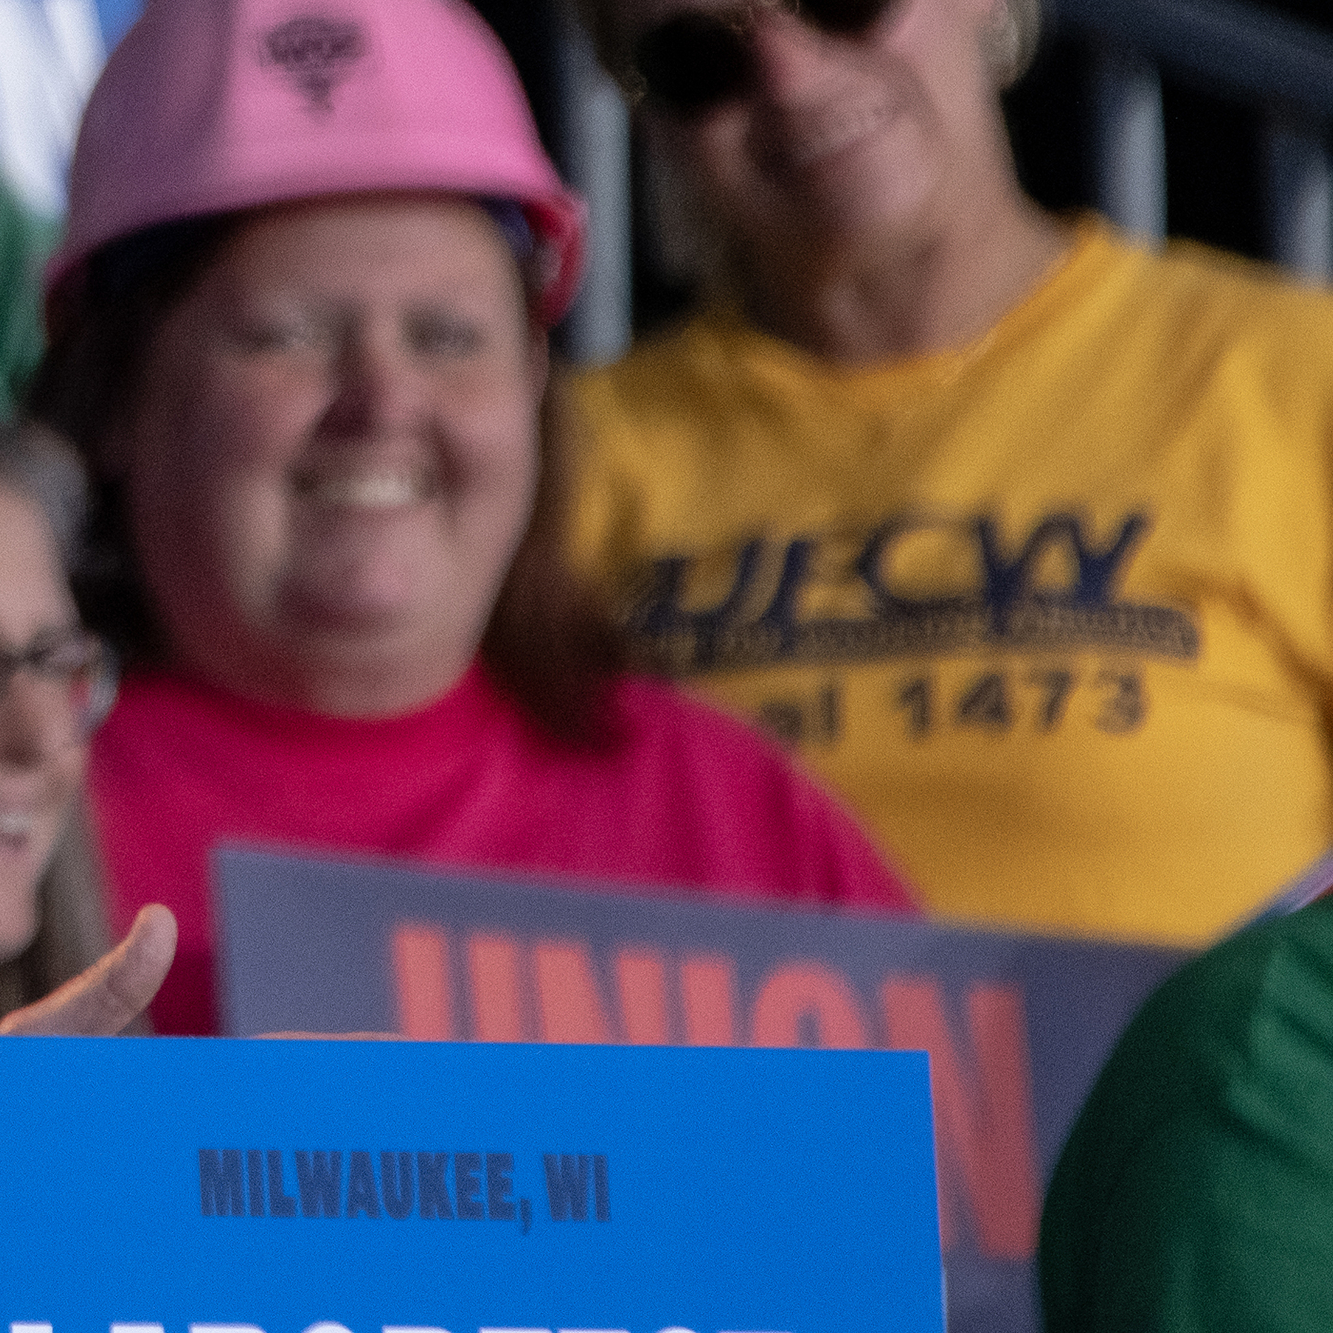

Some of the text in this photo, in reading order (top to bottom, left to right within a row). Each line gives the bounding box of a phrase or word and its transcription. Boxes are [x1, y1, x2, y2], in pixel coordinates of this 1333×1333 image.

[893, 664, 1151, 742] 1473
[197, 1147, 614, 1236] MILWAUKEE, WI
